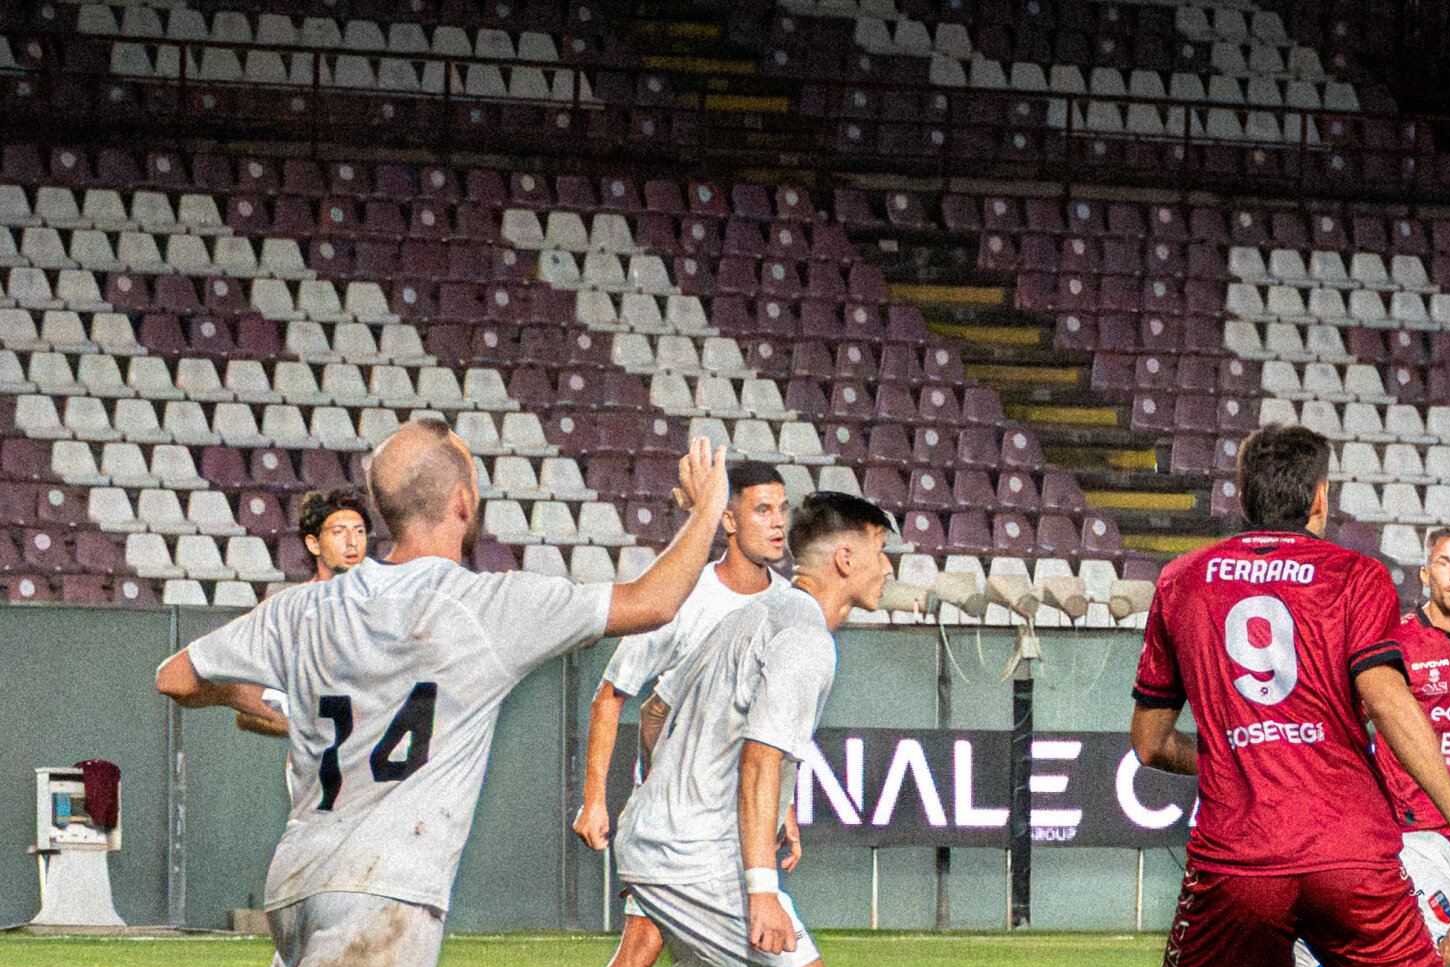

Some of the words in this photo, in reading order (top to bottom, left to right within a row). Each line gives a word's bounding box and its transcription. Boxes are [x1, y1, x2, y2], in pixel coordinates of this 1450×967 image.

[1206, 558, 1316, 585] FERRARO
[1225, 595, 1299, 706] 9
[319, 681, 439, 811] 14
